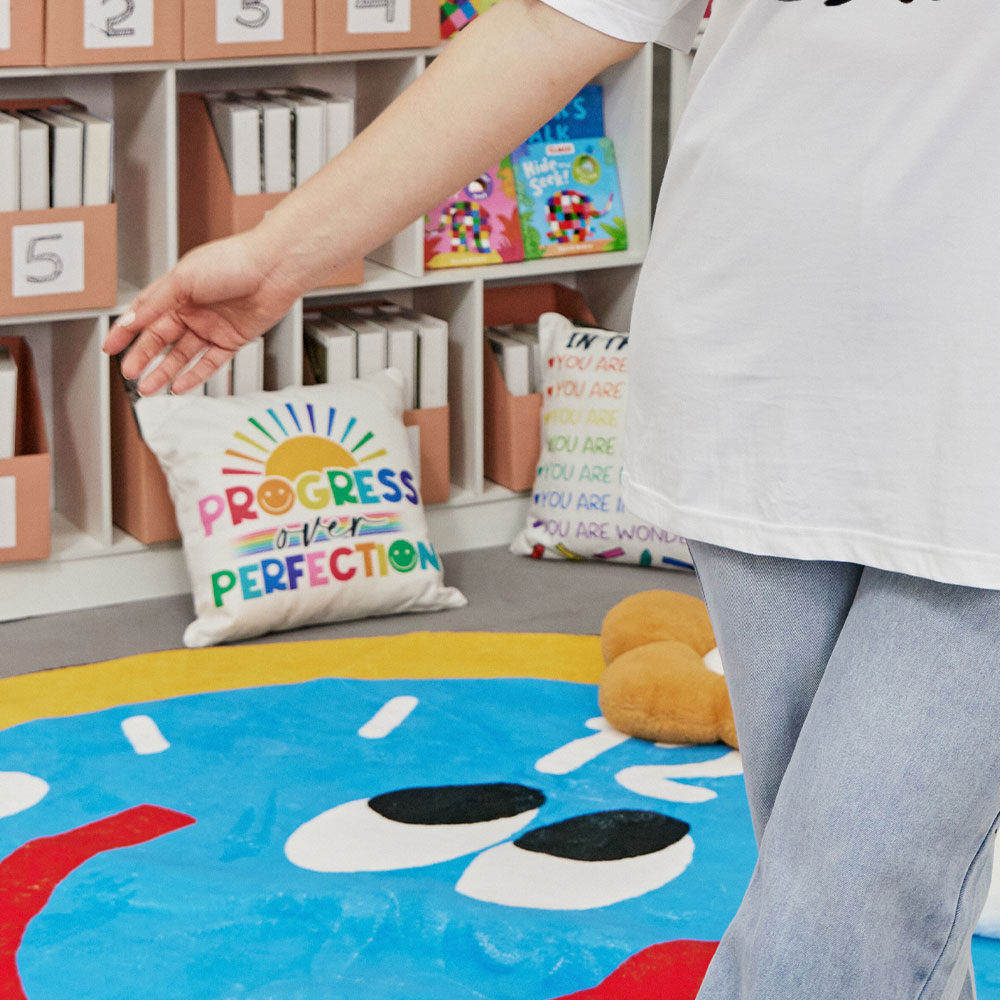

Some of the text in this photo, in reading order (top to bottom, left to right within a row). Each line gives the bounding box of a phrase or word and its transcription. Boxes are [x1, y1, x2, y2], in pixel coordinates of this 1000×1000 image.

[527, 124, 570, 144] ALK
[522, 157, 557, 179] Hide
[26, 233, 64, 284] 5
[595, 356, 628, 373] ARE
[590, 381, 625, 399] ARE
[583, 436, 616, 455] ARE
[578, 465, 613, 484] ARE
[198, 467, 419, 537] PROGRESS
[541, 491, 573, 509] YOU
[576, 493, 611, 512] ARE
[276, 515, 388, 550] over
[575, 521, 609, 540] ARE
[616, 523, 686, 545] WOND
[211, 539, 441, 609] PERFECTION
